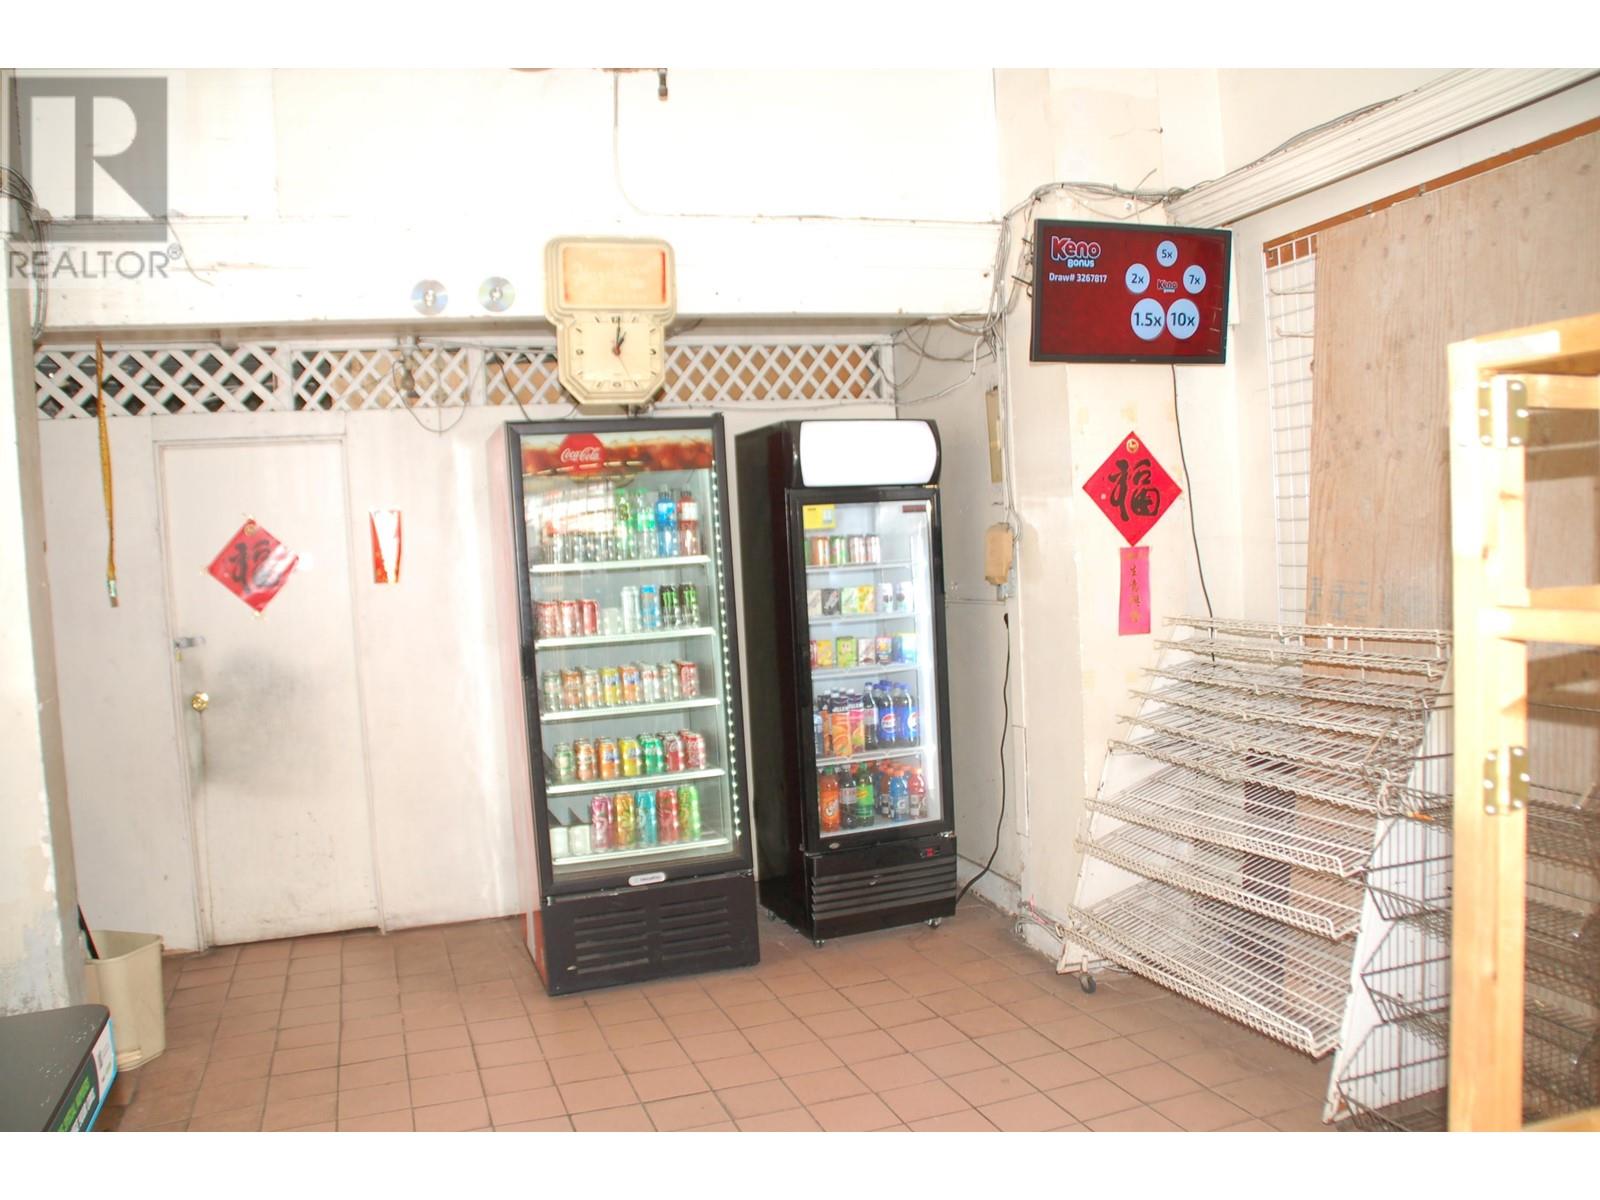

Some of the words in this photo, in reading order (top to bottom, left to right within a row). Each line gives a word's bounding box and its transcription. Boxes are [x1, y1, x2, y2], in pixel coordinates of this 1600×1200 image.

[1051, 236, 1101, 261] Keno
[1161, 249, 1173, 259] 5x
[1049, 272, 1075, 282] Draw#
[1076, 273, 1108, 283] 3267817
[1131, 273, 1144, 284] 2x
[1189, 274, 1201, 285] 7x
[1134, 312, 1162, 327] 1.5x
[1171, 312, 1196, 327] 10x
[560, 446, 601, 464] Coca-Cola
[1108, 458, 1160, 521] 福
